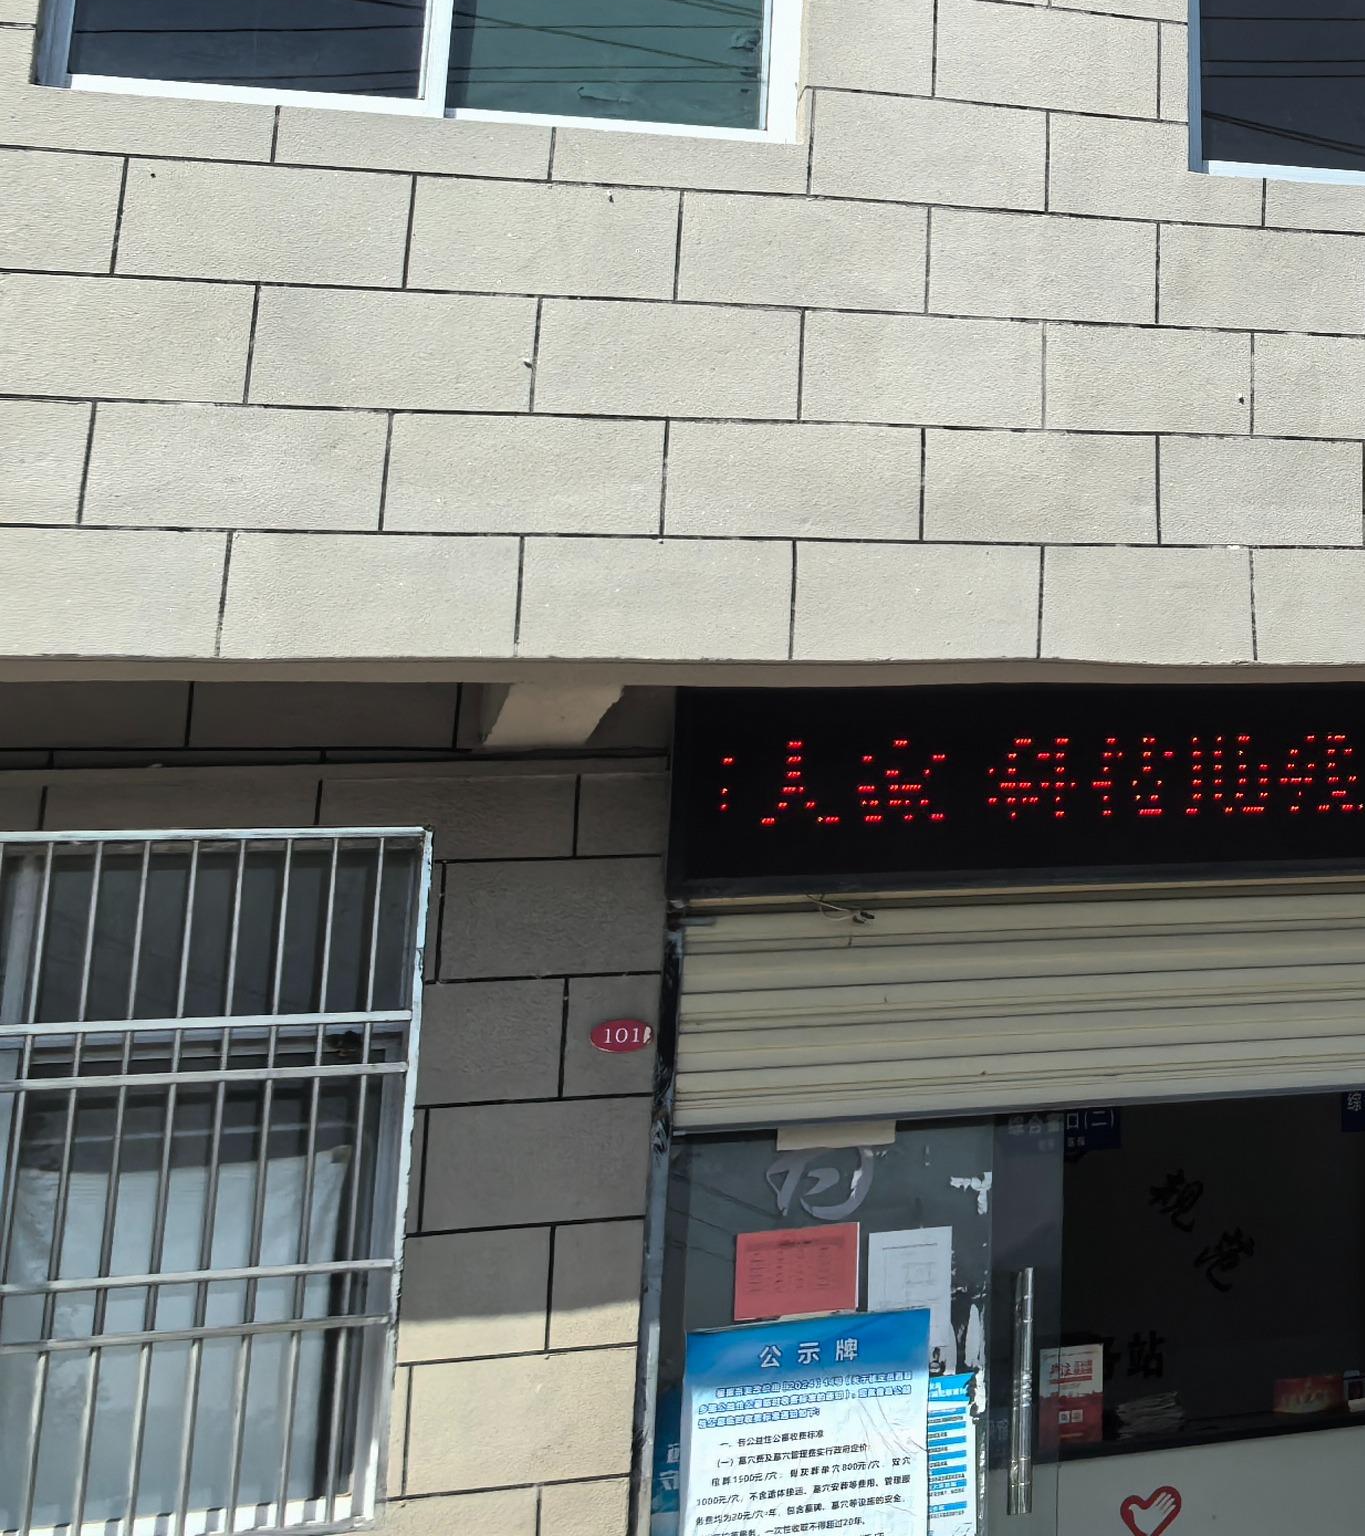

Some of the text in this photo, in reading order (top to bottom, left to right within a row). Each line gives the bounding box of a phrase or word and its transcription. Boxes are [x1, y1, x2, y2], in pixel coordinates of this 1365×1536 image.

[604, 1028, 640, 1044] 101
[759, 1338, 858, 1369] 公示牌
